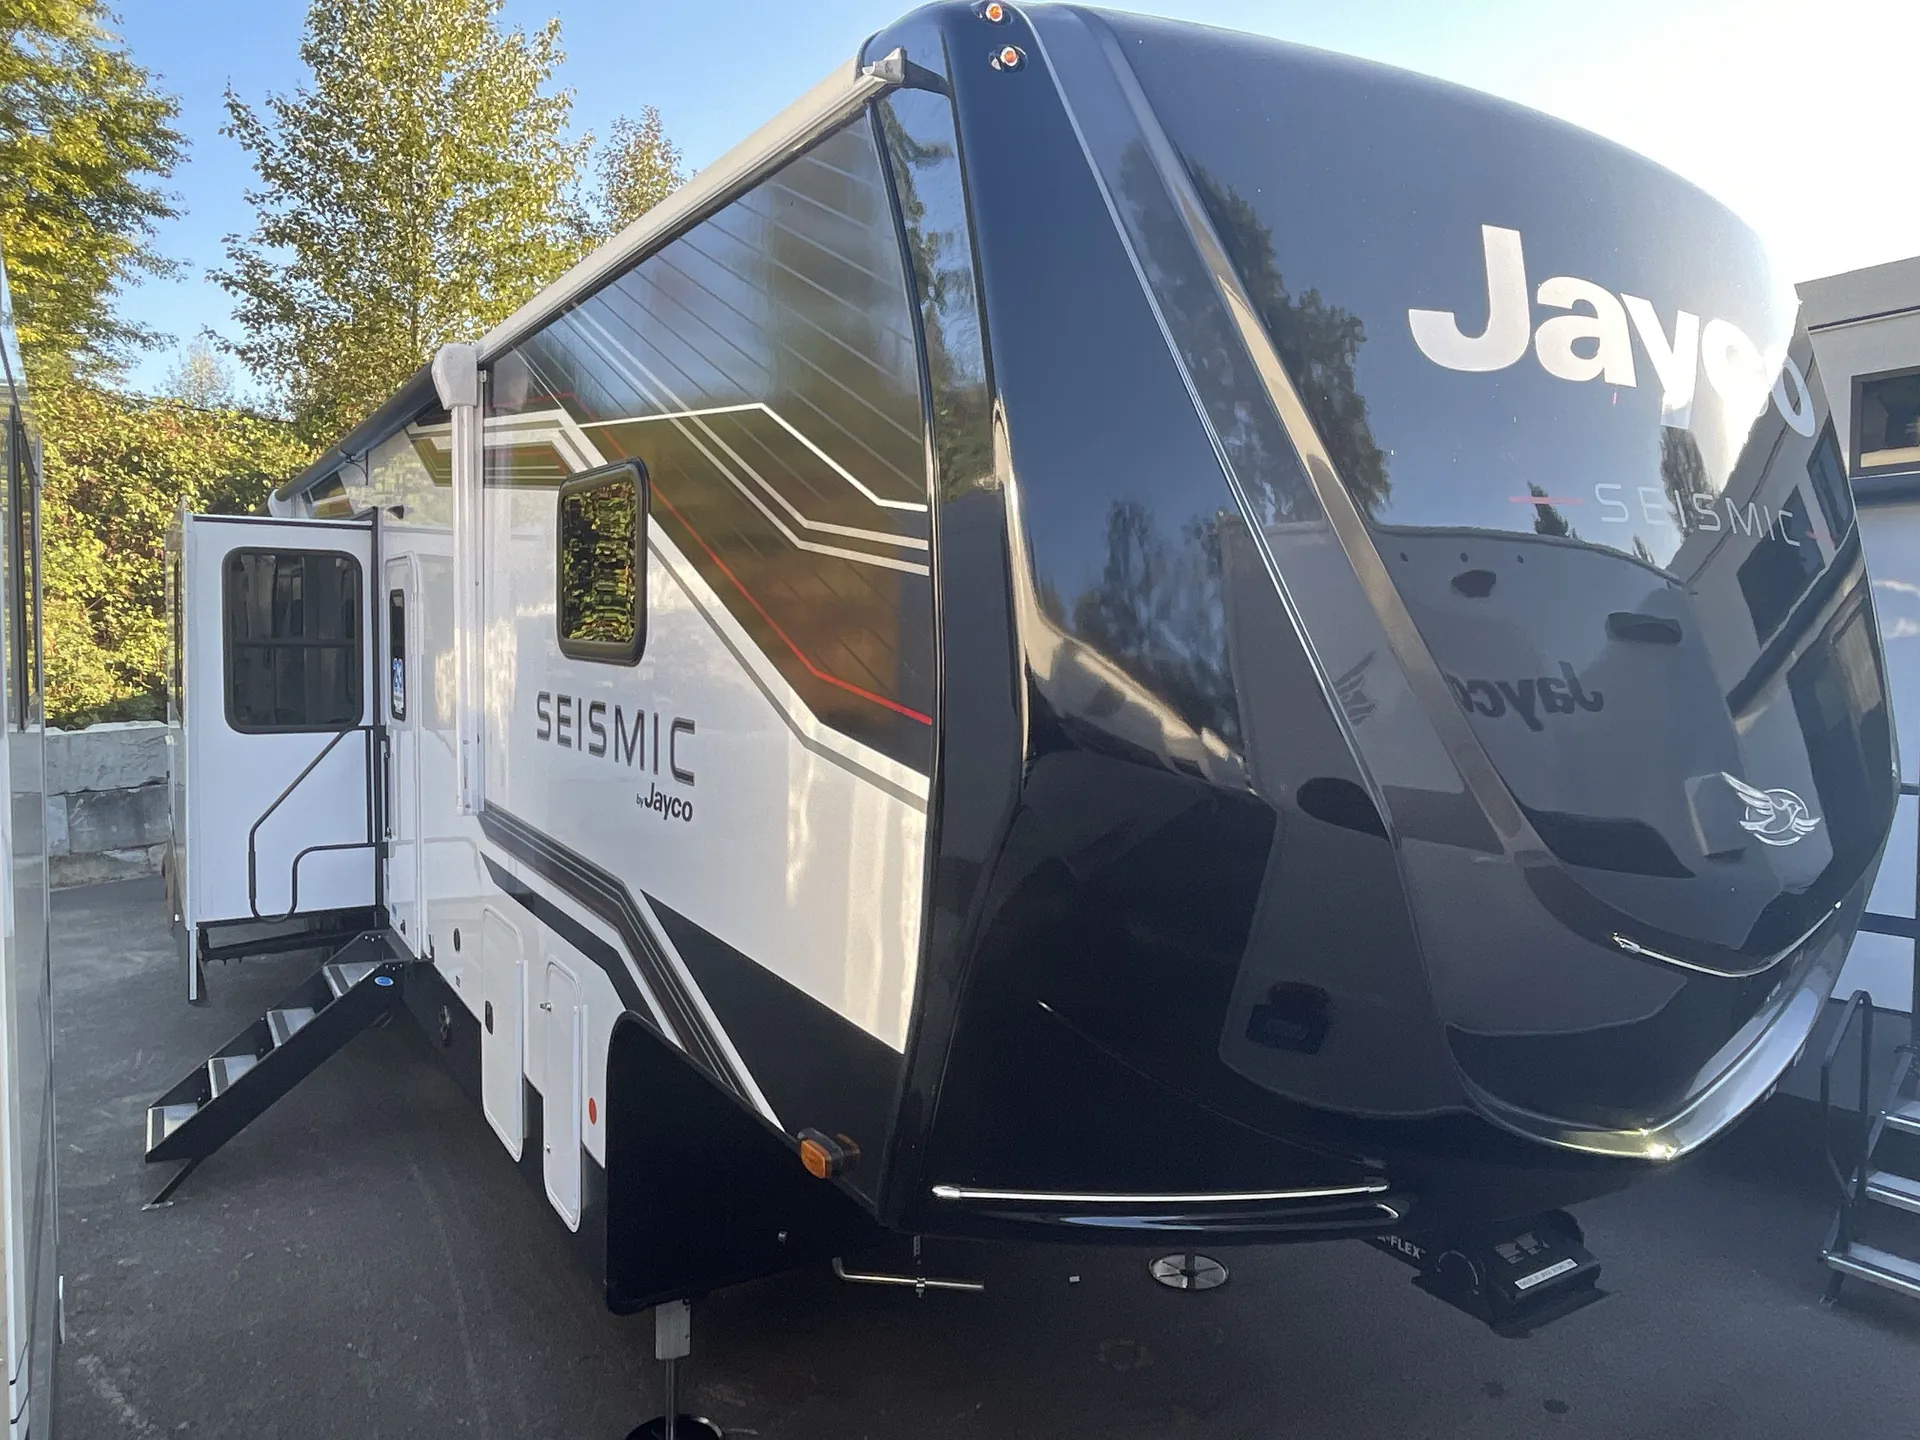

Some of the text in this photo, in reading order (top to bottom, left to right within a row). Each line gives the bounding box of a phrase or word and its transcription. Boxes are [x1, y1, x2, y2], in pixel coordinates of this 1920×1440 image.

[1594, 482, 1800, 547] SEISMIC
[536, 690, 696, 787] SEISMIC
[644, 782, 693, 822] Jayco
